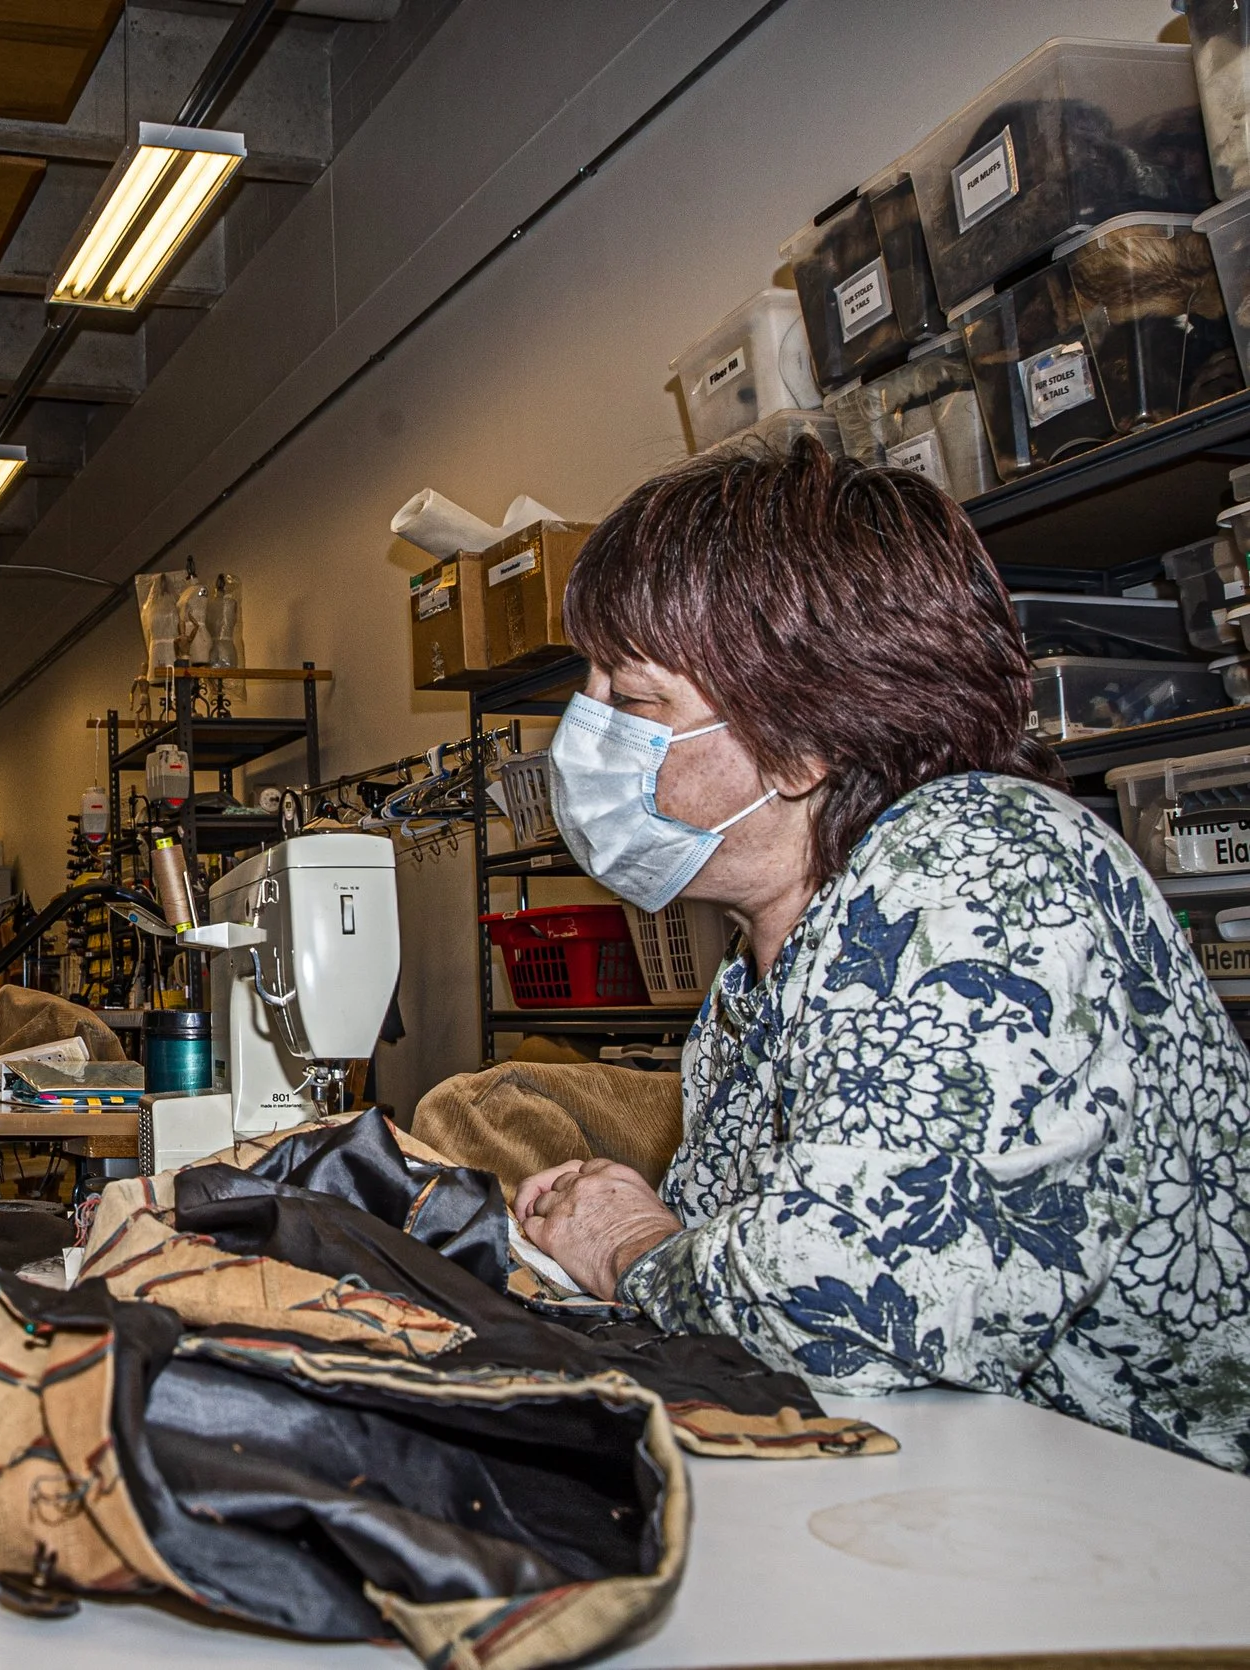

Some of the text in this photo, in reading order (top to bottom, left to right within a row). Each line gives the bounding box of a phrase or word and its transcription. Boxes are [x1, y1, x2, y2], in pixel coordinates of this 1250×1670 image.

[967, 161, 1001, 191] FUR MUFFS
[844, 283, 874, 307] FUR STOLES
[855, 297, 870, 311] TAILS
[710, 357, 738, 385] Fiber fill
[1035, 369, 1075, 391] FUR STOLES
[1043, 385, 1070, 402] & TAILS
[1216, 836, 1250, 865] Ela
[272, 1093, 290, 1102] 801
